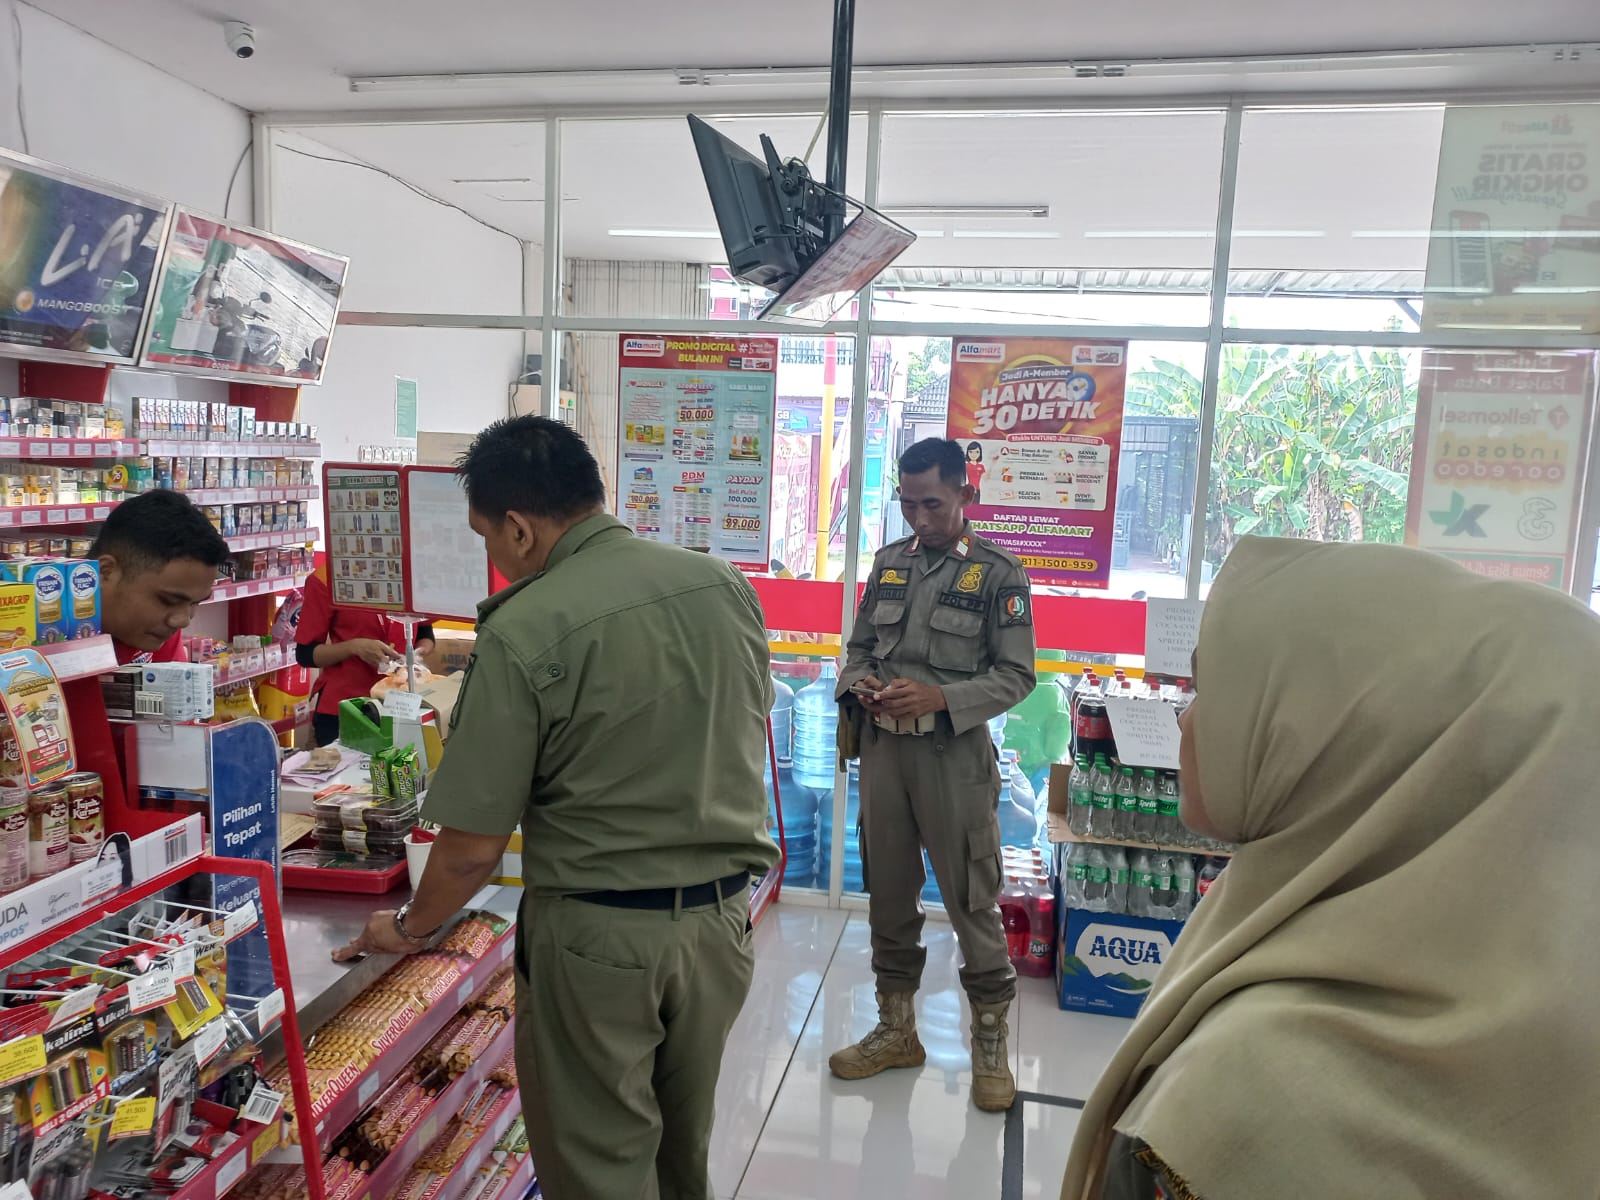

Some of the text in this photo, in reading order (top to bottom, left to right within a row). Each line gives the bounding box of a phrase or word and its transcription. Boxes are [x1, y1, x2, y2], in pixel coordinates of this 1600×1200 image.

[37, 298, 130, 315] MANGOBOOST
[626, 340, 662, 350] Alfamart
[666, 341, 700, 351] PROMO
[701, 342, 736, 352] DIGITAL
[960, 345, 1001, 355] Alfamart
[678, 353, 709, 363] BULAN
[710, 355, 724, 364] INI
[1002, 368, 1071, 381] Jadi A-Member
[980, 382, 1069, 408] HANYA
[679, 409, 714, 420] 50.000
[972, 401, 1101, 435] 30 DETIK
[725, 475, 763, 485] PAYDAY
[728, 496, 757, 504] 100.000
[725, 517, 761, 530] 99.000
[993, 513, 1060, 524] DAFTAR LEWAT
[1028, 524, 1094, 538] ALFAMART
[1155, 622, 1196, 631] COCA-COL
[73, 807, 100, 820] Kurma
[222, 802, 262, 827] Pilihan
[224, 820, 262, 848] Tepat
[1088, 935, 1162, 965] AQUA
[45, 1021, 95, 1053] kaline
[66, 1093, 98, 1118] GRATIS
[97, 1082, 106, 1097] 1
